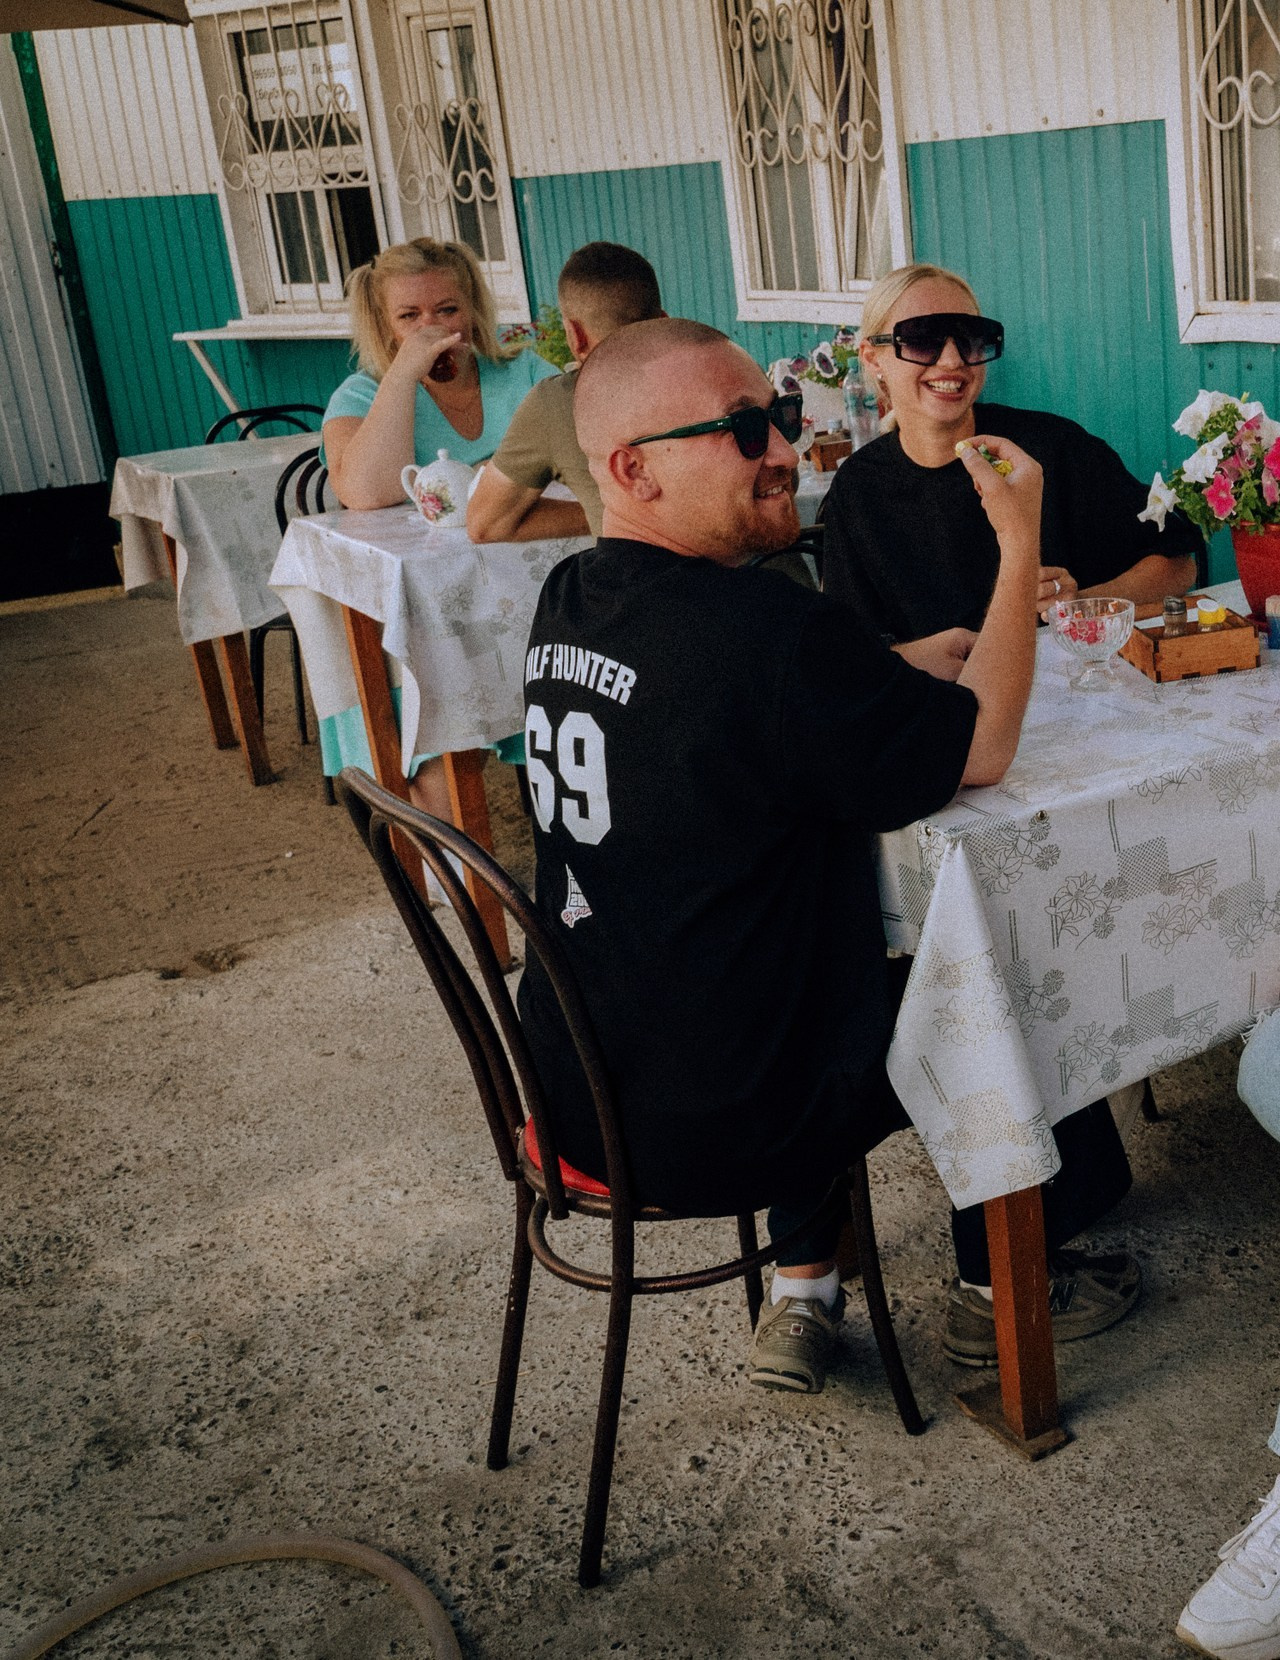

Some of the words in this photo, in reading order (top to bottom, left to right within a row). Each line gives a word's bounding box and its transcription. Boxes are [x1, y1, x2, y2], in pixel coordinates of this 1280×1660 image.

[525, 643, 553, 687] ILF
[551, 643, 637, 706] HUNTER
[525, 704, 611, 846] 69
